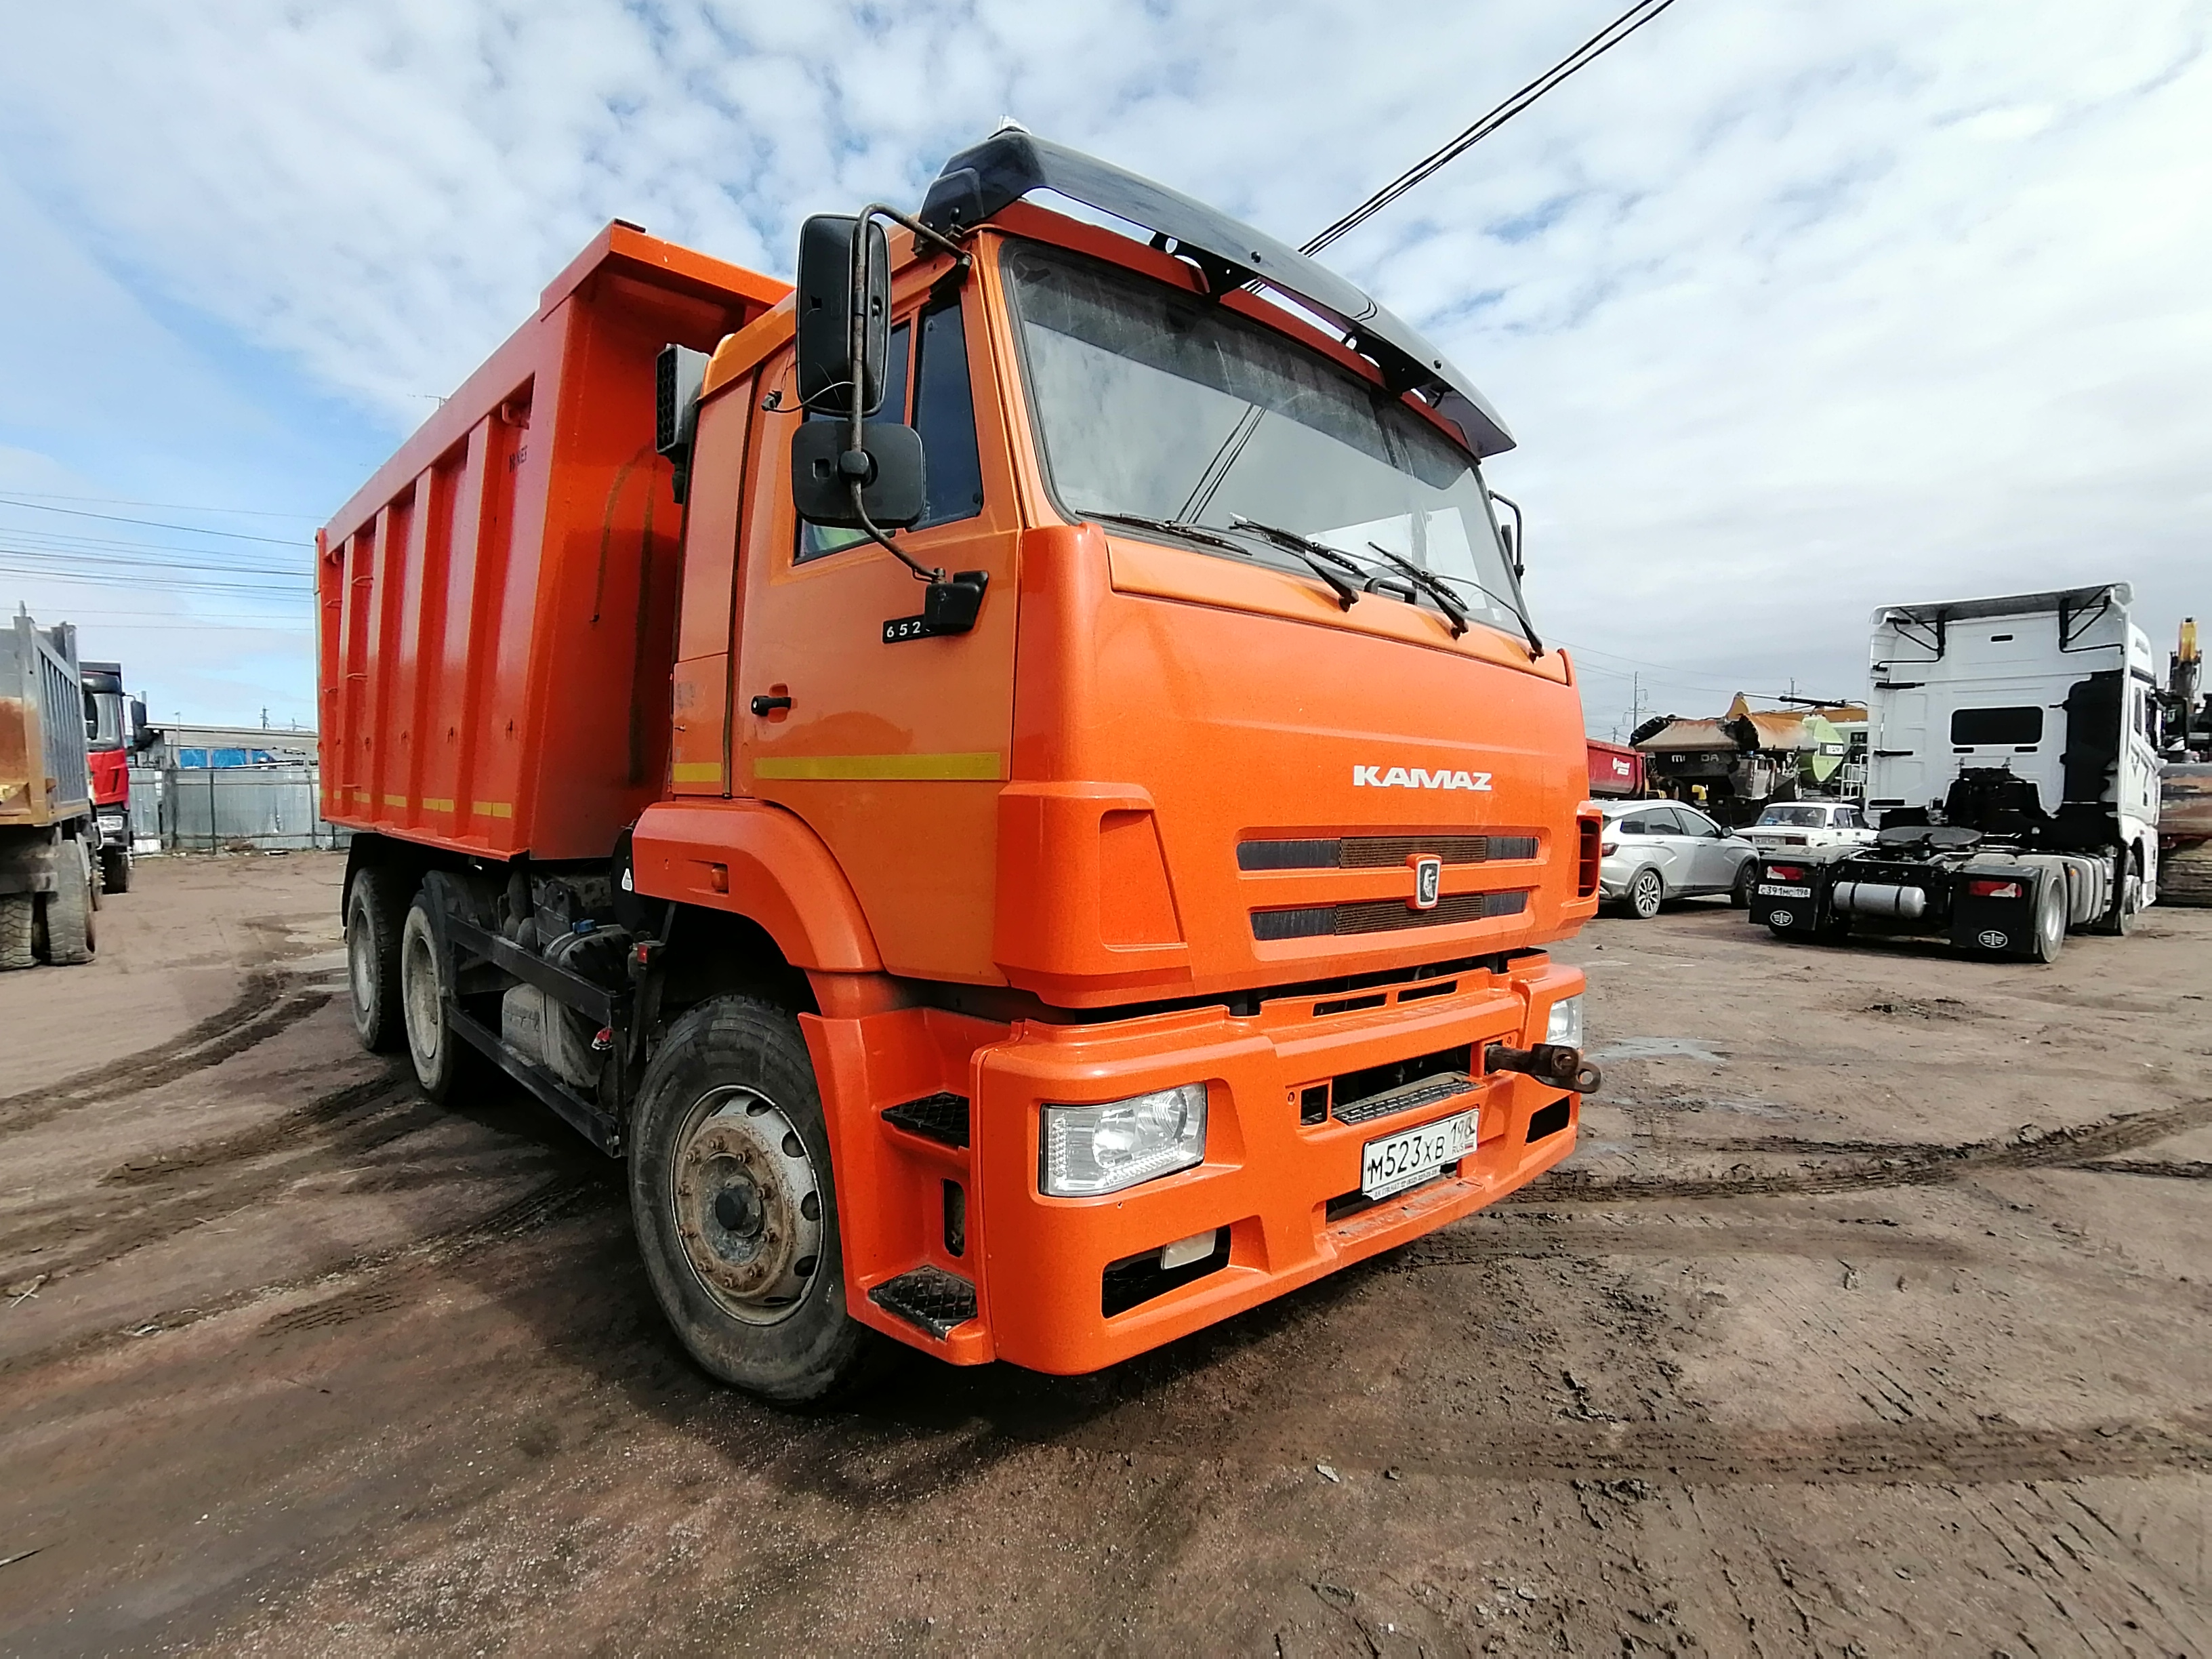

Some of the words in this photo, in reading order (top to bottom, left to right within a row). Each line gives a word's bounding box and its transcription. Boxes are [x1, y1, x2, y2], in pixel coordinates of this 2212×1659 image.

[886, 621, 930, 638] 652
[1353, 765, 1492, 791] KAMAZ
[1452, 1143, 1464, 1155] RUS
